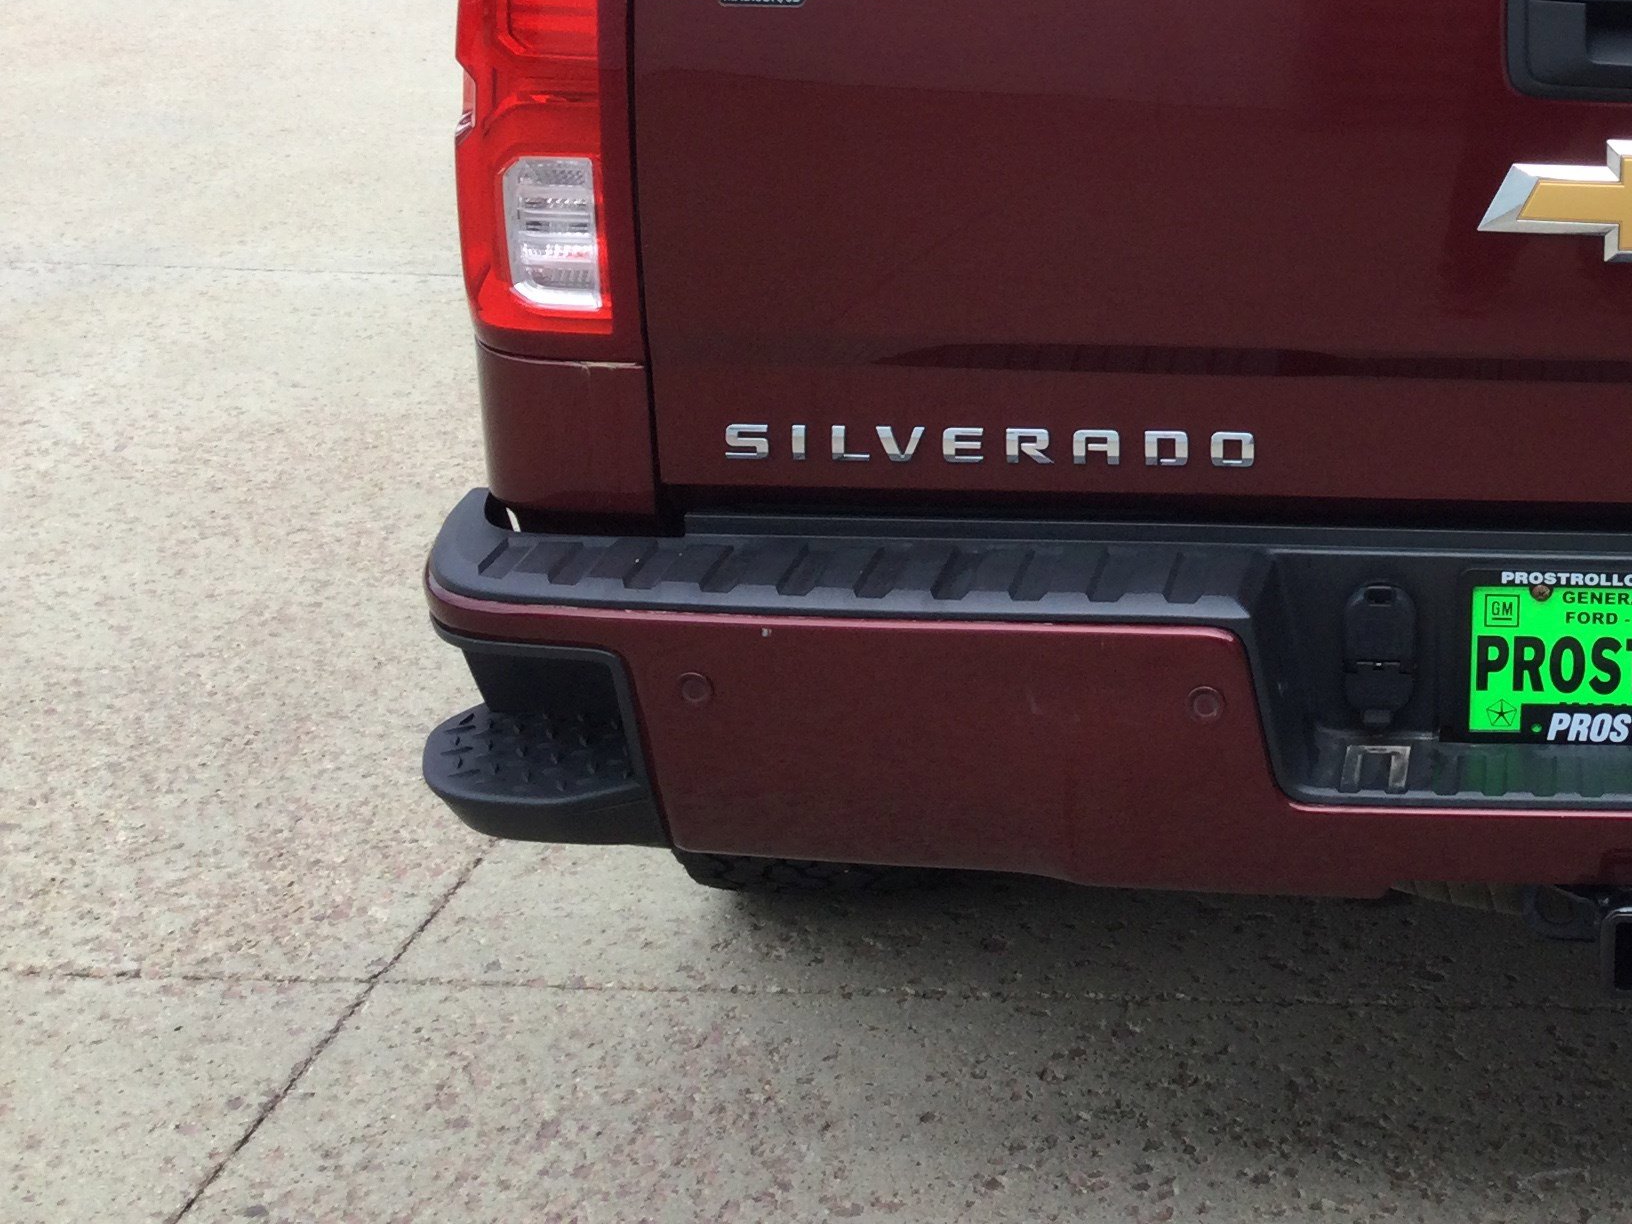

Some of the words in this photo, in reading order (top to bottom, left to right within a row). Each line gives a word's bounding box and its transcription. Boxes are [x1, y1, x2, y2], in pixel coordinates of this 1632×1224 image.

[725, 423, 1256, 468] SILVERADO
[1491, 601, 1513, 617] GM
[1565, 611, 1619, 625] FORD
